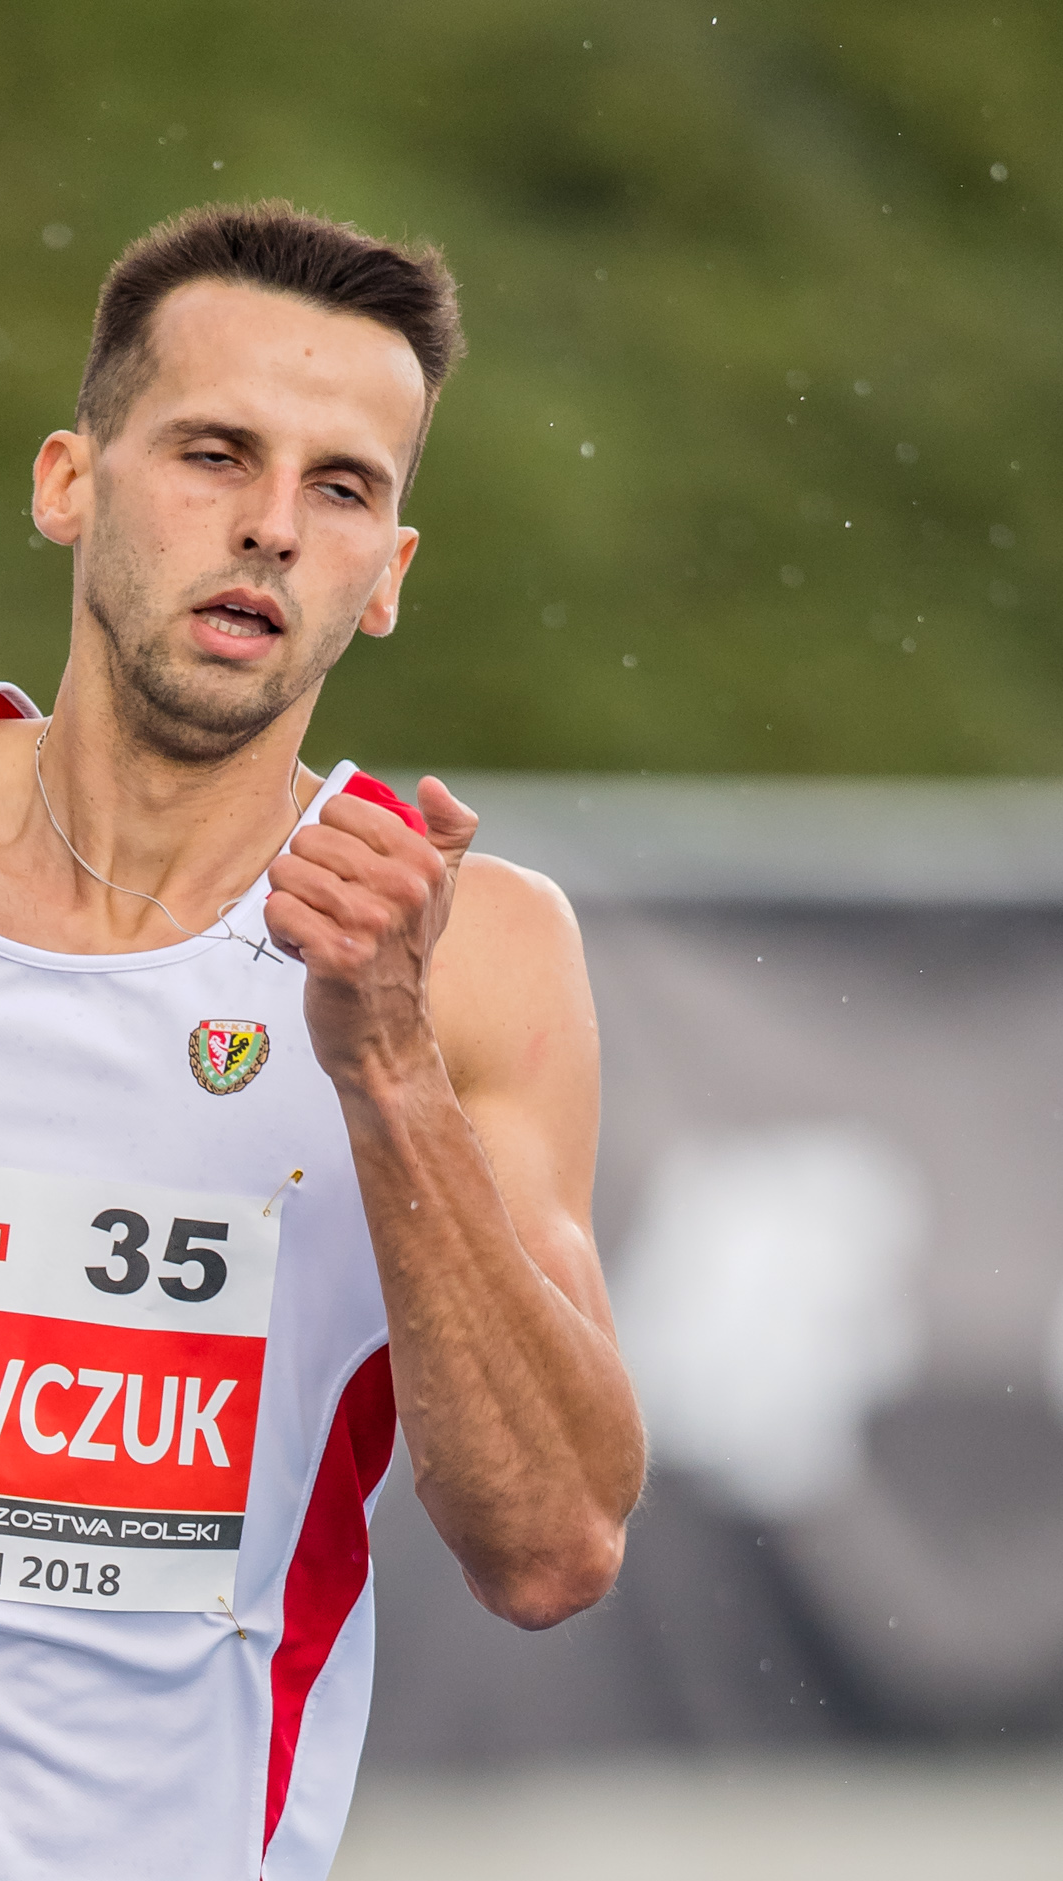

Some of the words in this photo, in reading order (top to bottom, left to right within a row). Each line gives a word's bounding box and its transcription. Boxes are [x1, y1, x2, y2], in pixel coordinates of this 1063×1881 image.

[84, 1208, 229, 1302] 35
[120, 1521, 220, 1542] POLSKI
[19, 1556, 122, 1596] 2018
